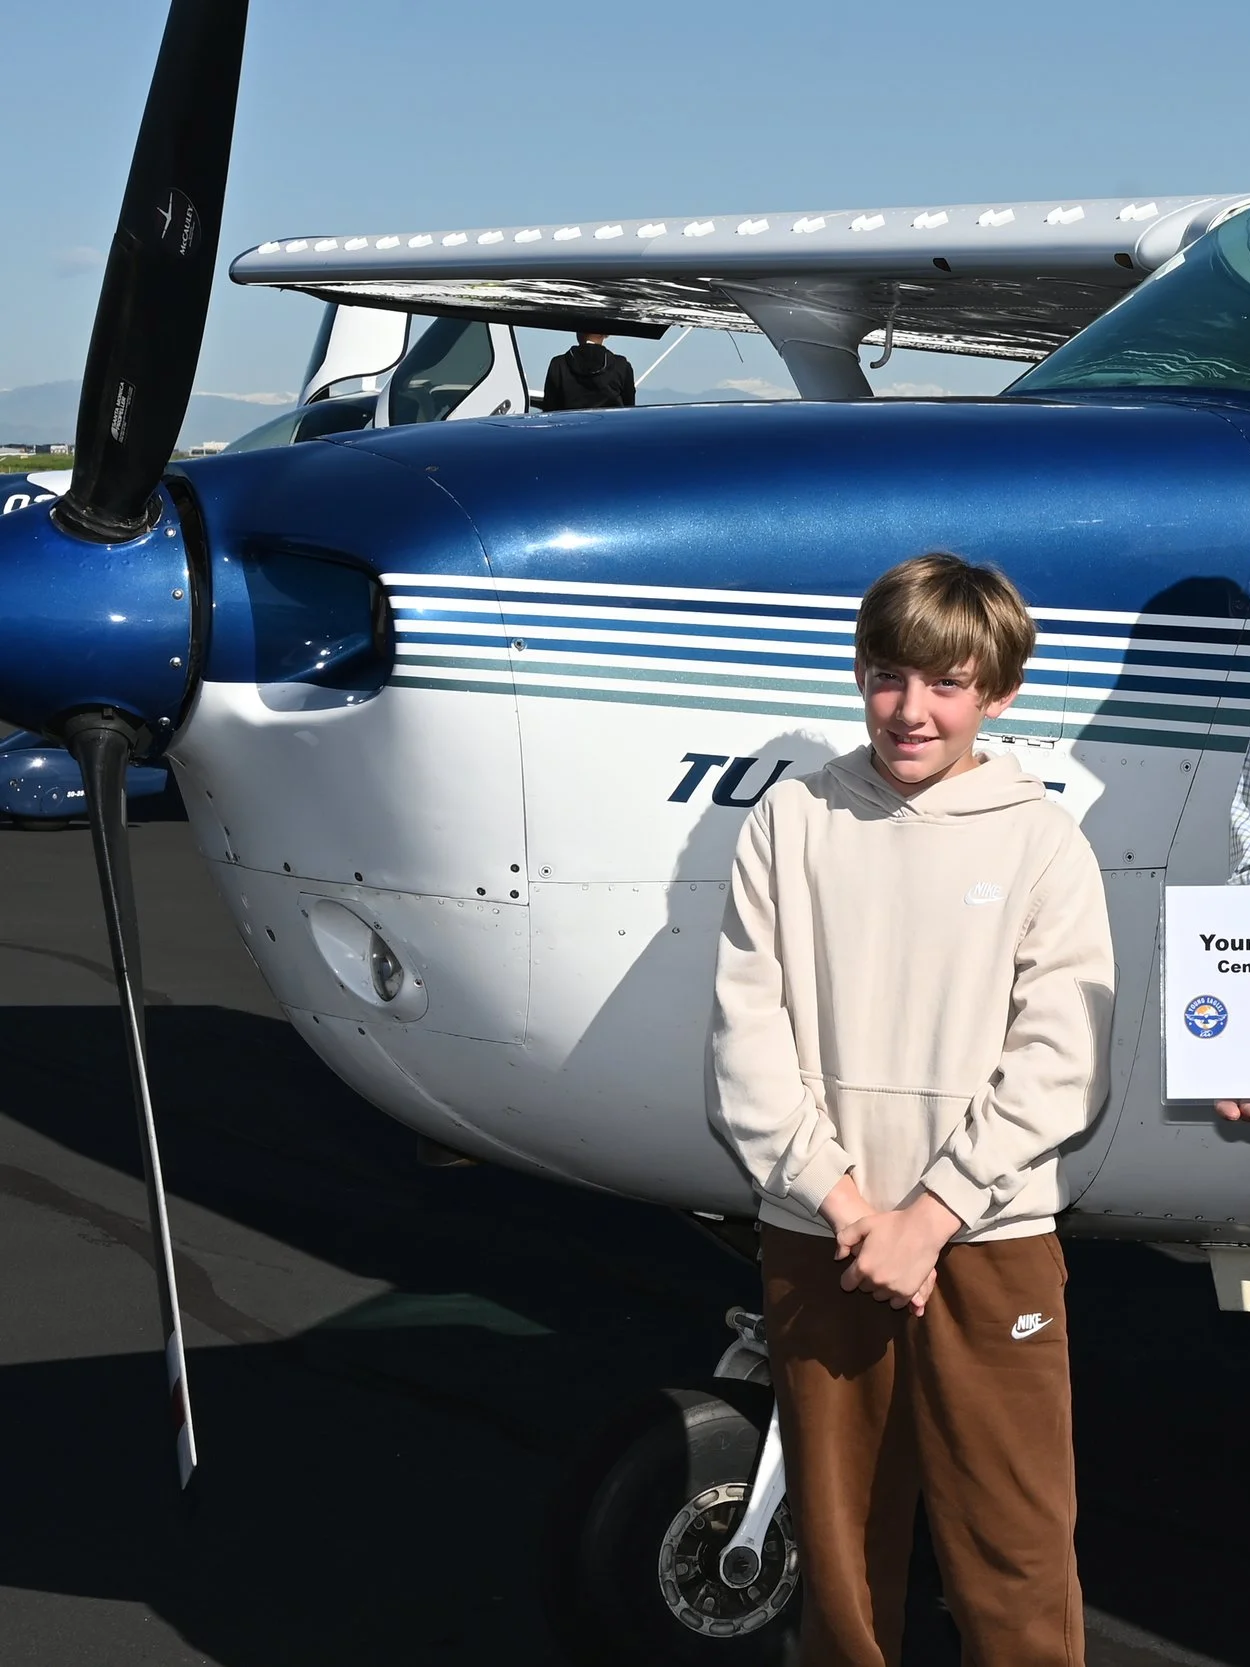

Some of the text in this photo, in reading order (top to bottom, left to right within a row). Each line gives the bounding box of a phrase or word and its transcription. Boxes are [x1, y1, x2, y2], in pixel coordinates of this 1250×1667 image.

[973, 882, 1000, 898] NIKE
[1188, 998, 1205, 1012] YOUNG
[1017, 1313, 1042, 1330] NIKE
